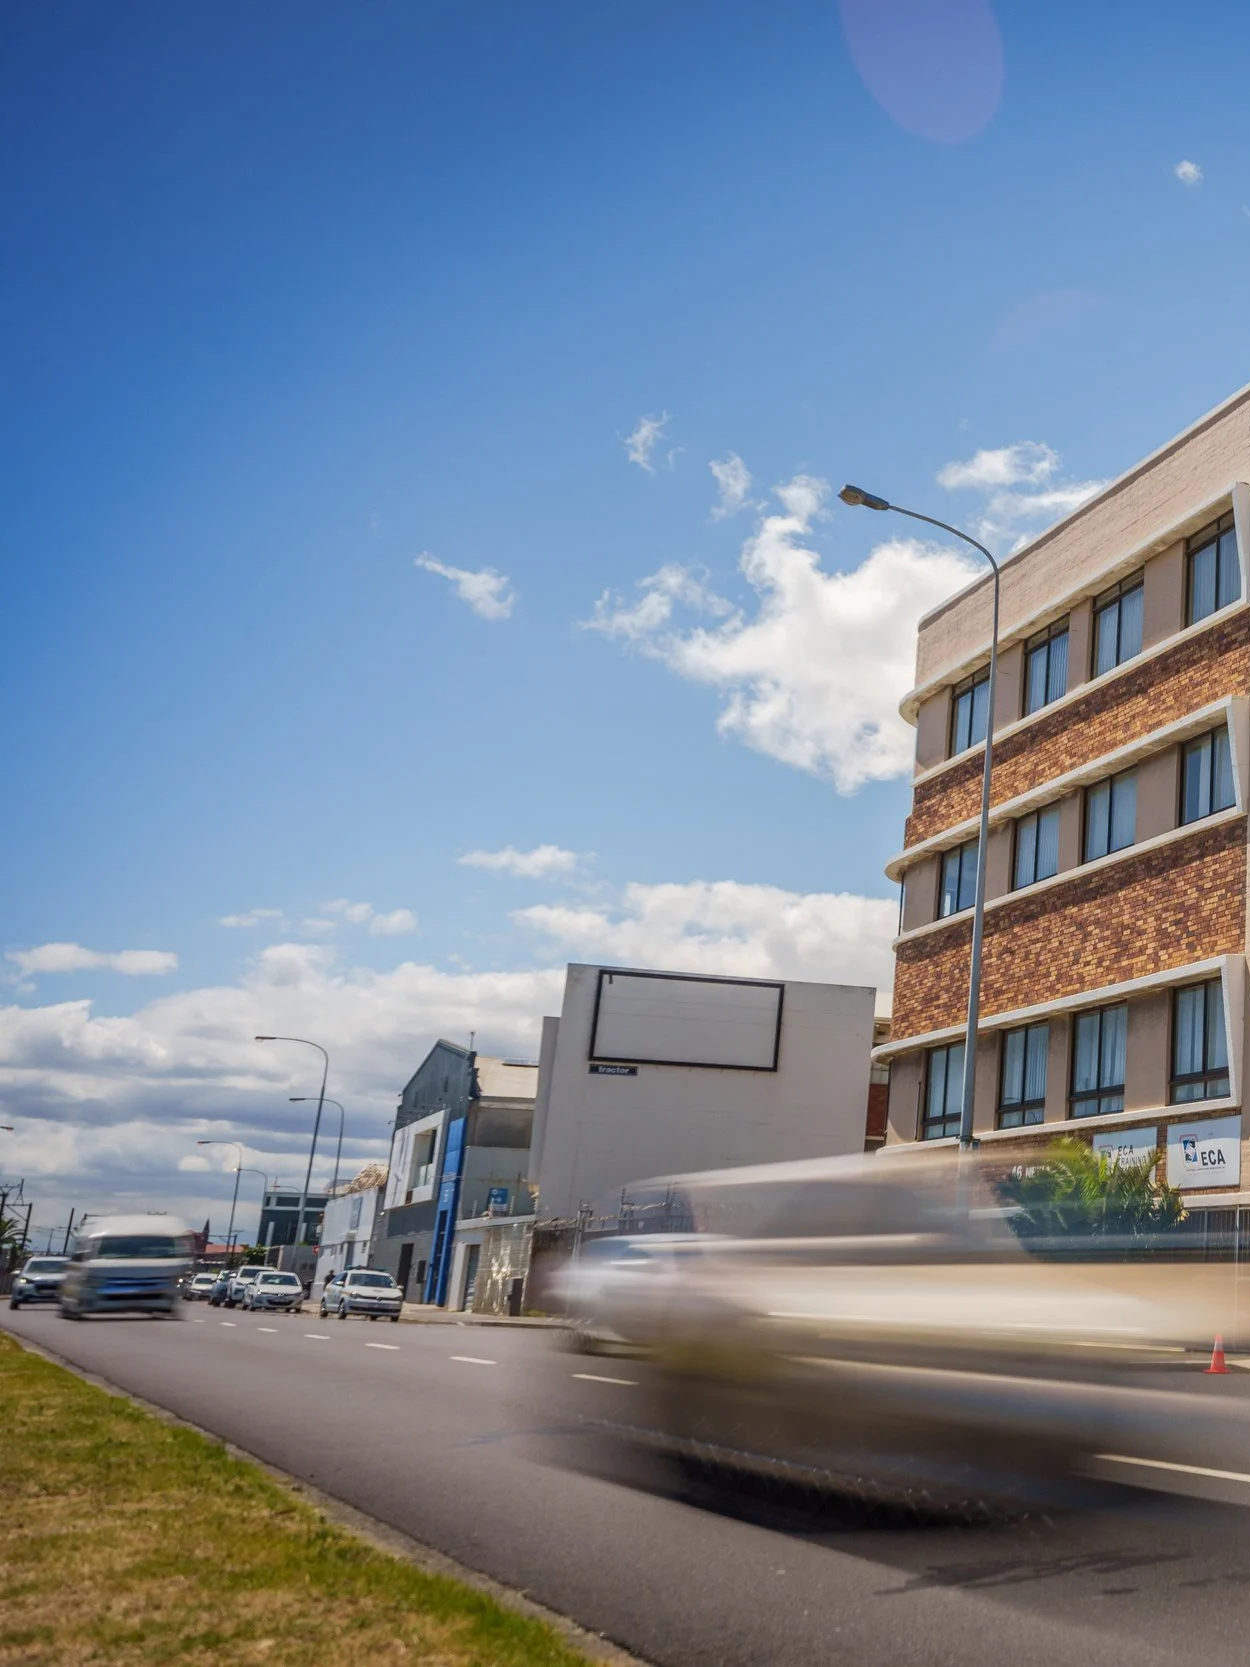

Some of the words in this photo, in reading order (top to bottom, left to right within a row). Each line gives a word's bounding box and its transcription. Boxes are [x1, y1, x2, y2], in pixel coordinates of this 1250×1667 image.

[598, 1065, 630, 1074] tractor
[1117, 1144, 1134, 1157] ECA
[1200, 1148, 1226, 1166] ECA
